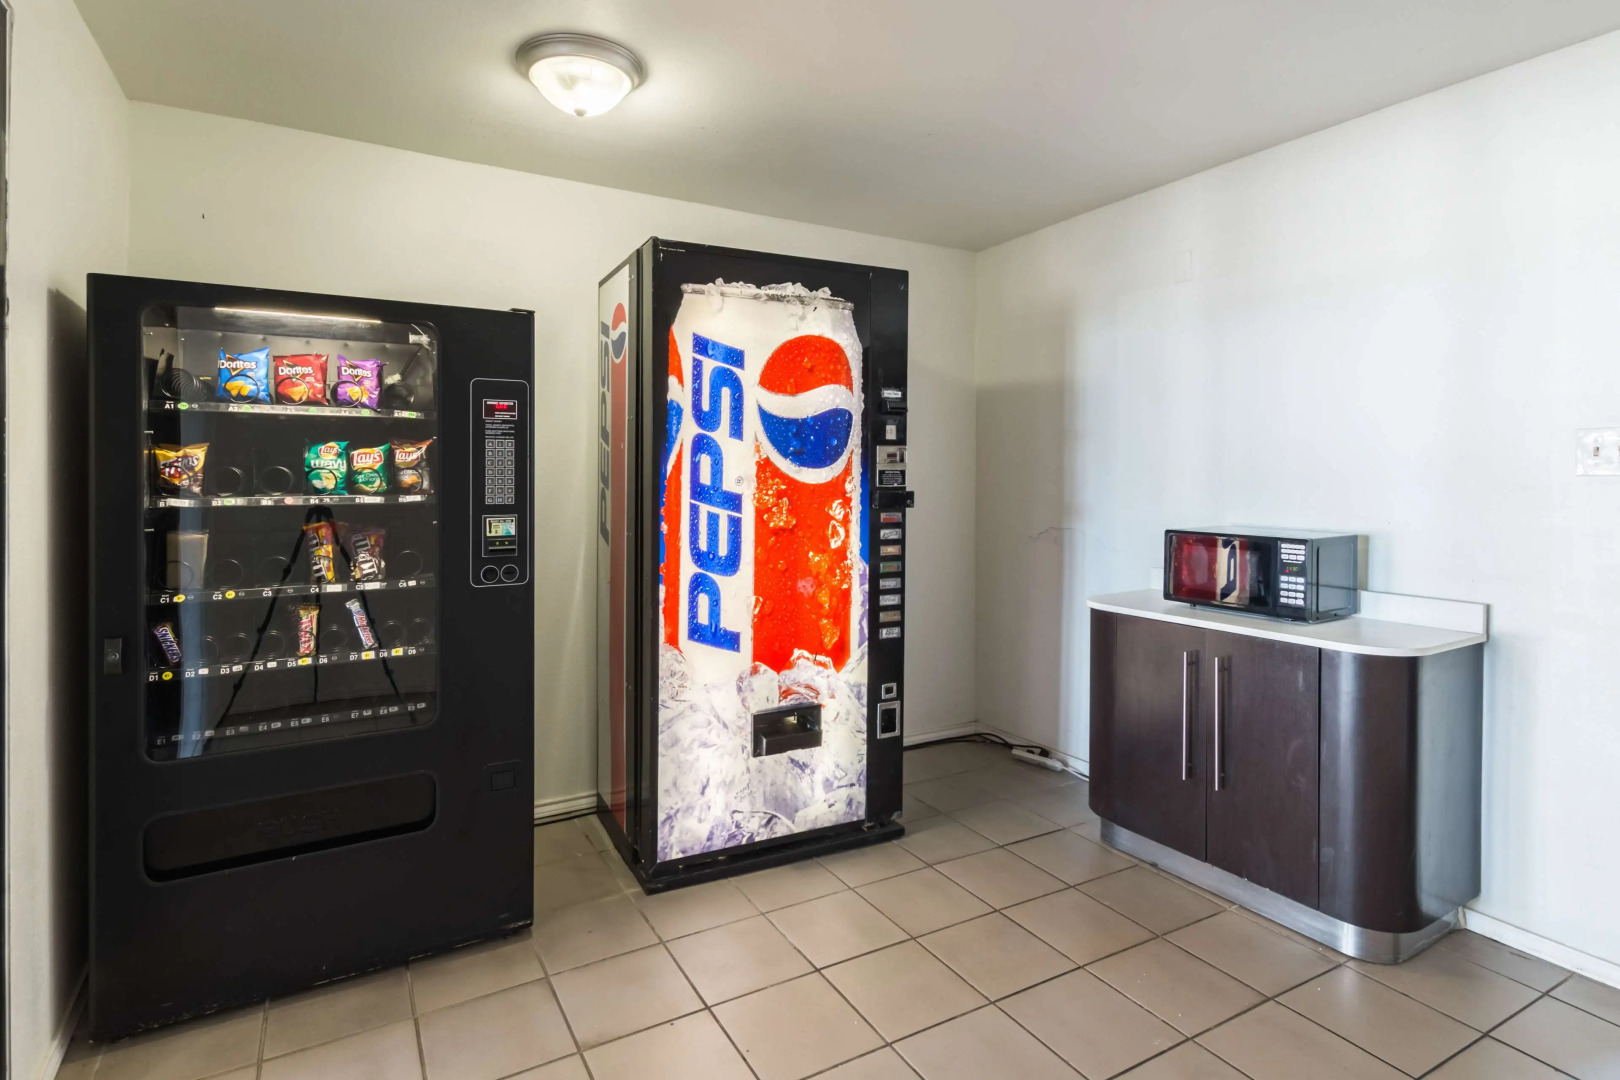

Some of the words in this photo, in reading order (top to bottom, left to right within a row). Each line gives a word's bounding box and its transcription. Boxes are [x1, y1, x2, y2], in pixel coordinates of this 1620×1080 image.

[219, 360, 257, 369] Doritos
[278, 366, 314, 376] Doritos
[341, 367, 372, 378] Doritos
[600, 320, 610, 547] PEPSI
[688, 332, 745, 653] PEPSI
[157, 627, 181, 661] SNICKERS
